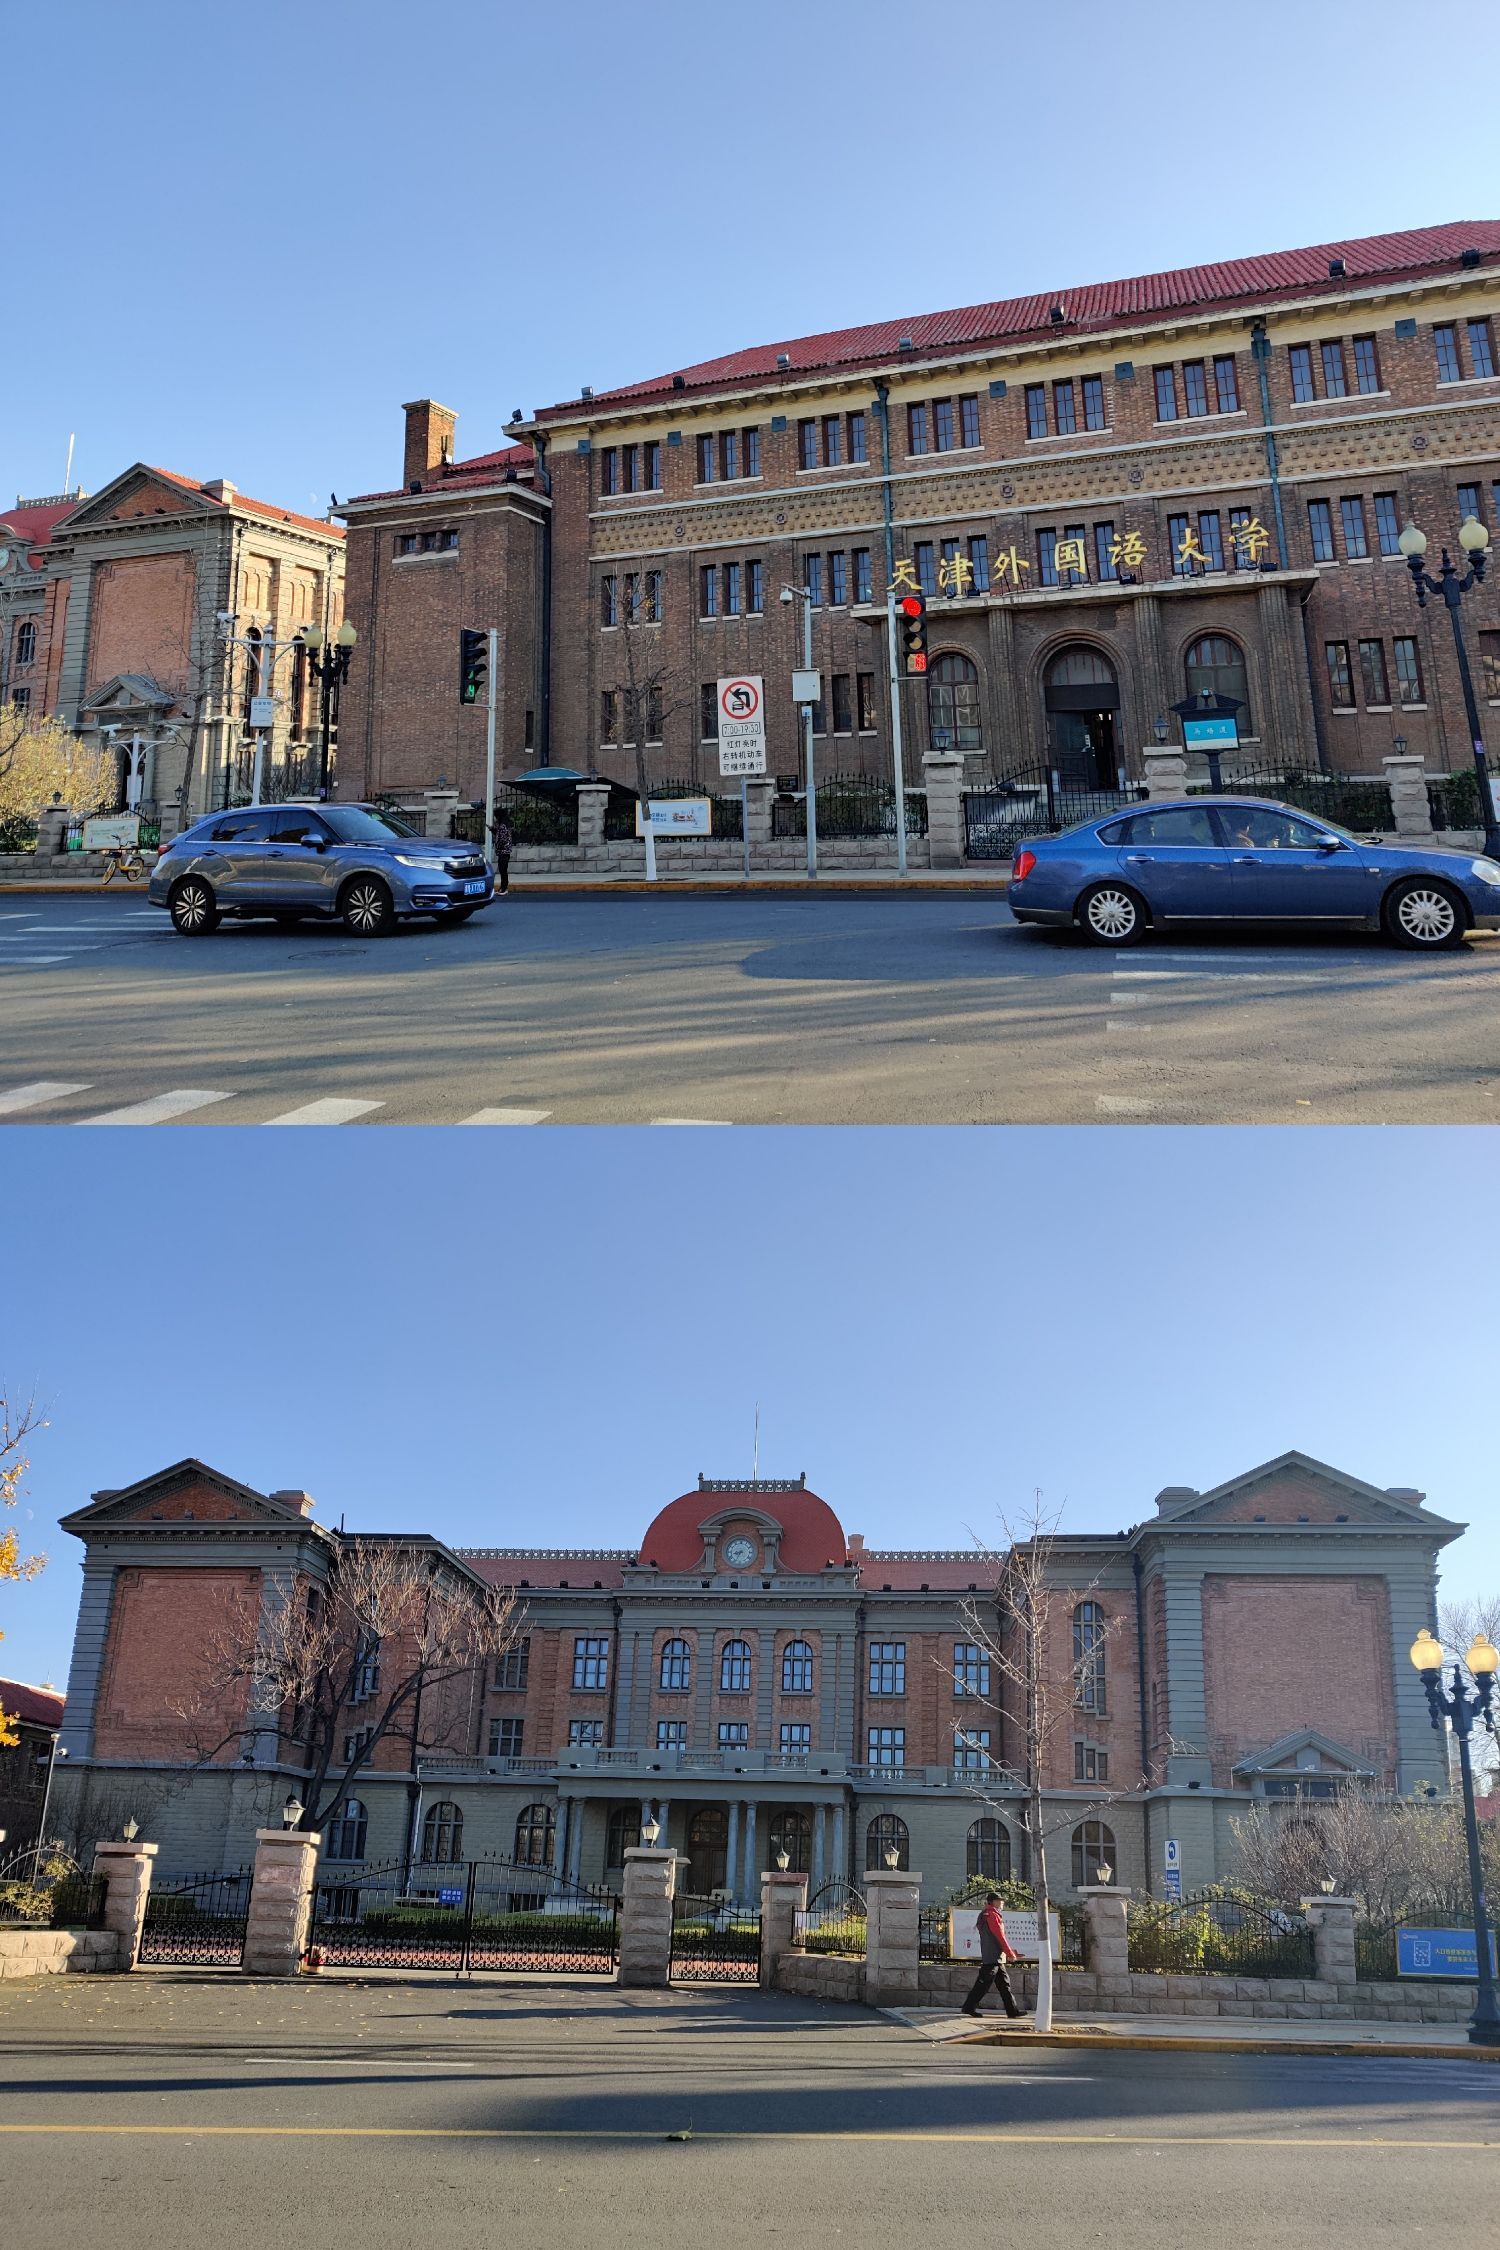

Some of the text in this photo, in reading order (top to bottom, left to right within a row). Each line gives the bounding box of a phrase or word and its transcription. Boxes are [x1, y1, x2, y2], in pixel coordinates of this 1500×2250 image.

[886, 518, 1270, 595] 天津外国语大学
[727, 739, 757, 749] 红灯亮时
[722, 750, 763, 761] 右转机动车
[723, 761, 763, 772] 可继续通行
